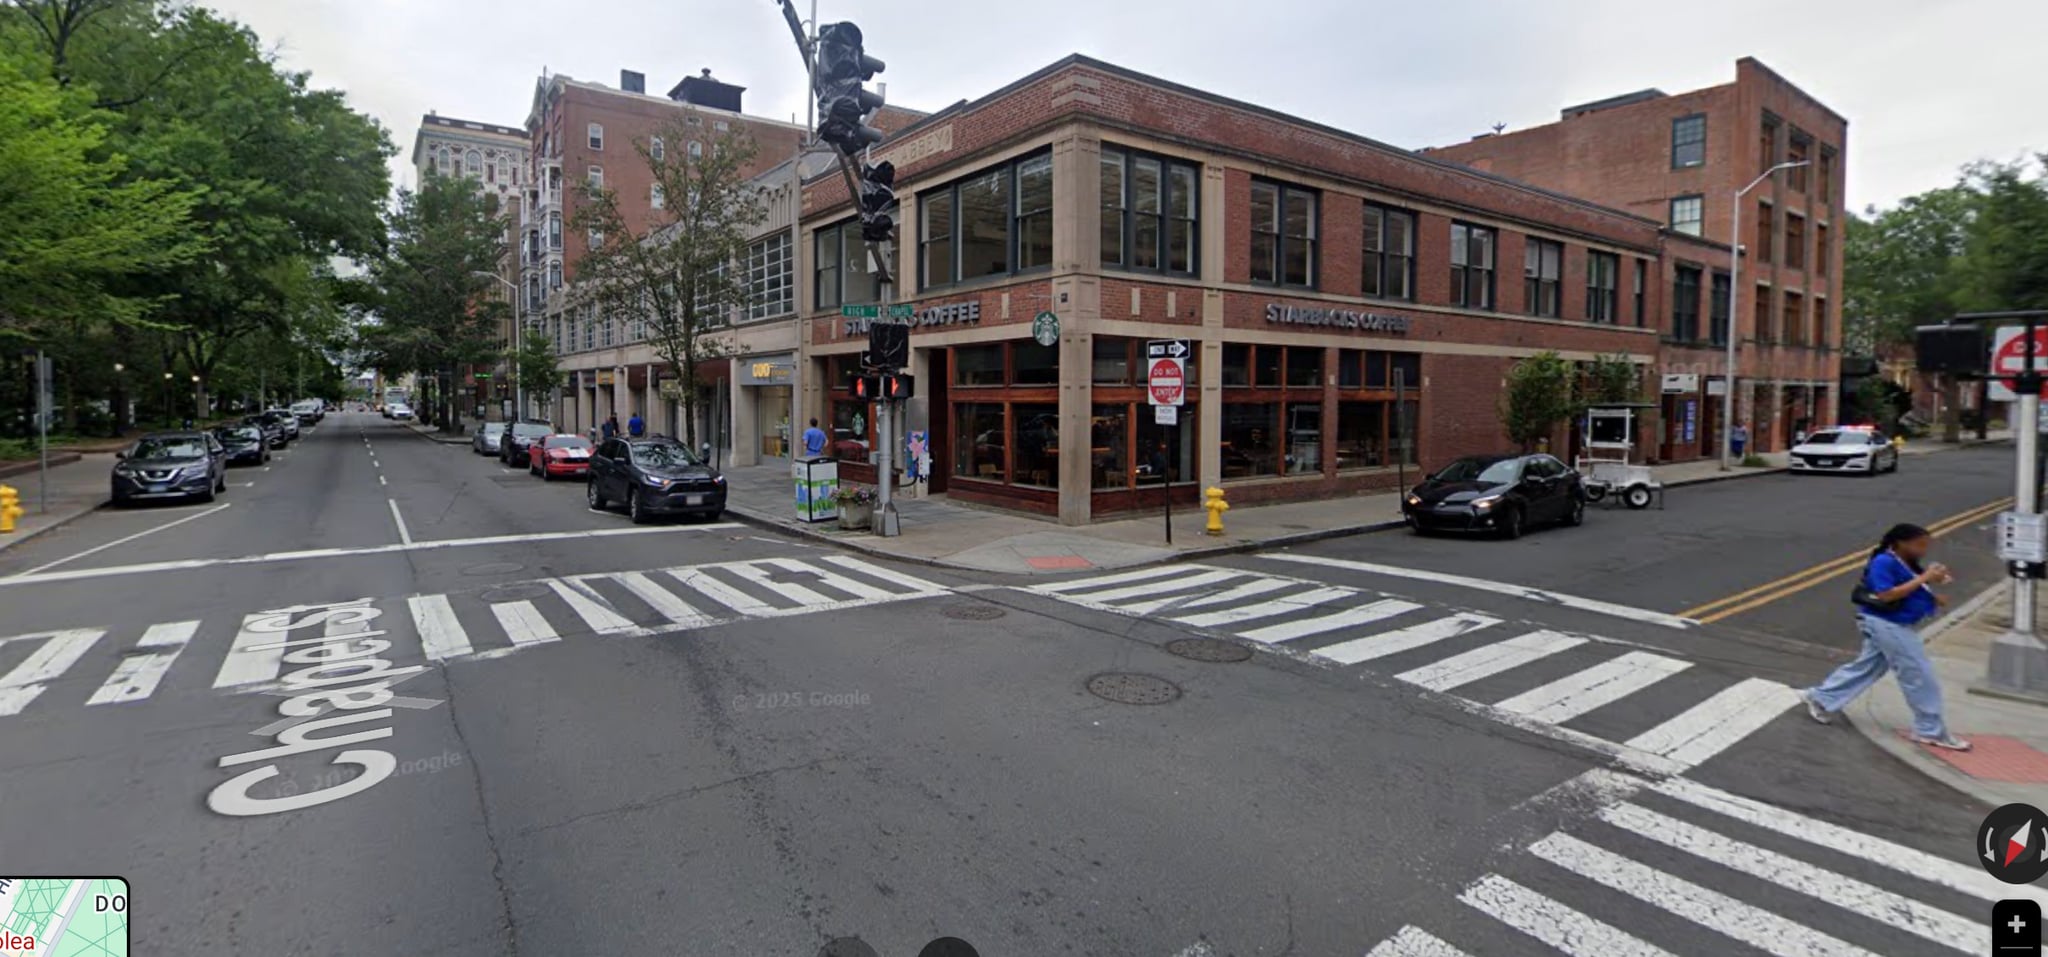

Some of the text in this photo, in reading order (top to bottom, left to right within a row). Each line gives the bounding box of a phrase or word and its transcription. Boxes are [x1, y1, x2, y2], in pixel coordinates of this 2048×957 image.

[920, 300, 980, 327] COFFEE
[1266, 303, 1409, 332] STARBUCKS COFFEE
[1154, 368, 1178, 376] DO NOT
